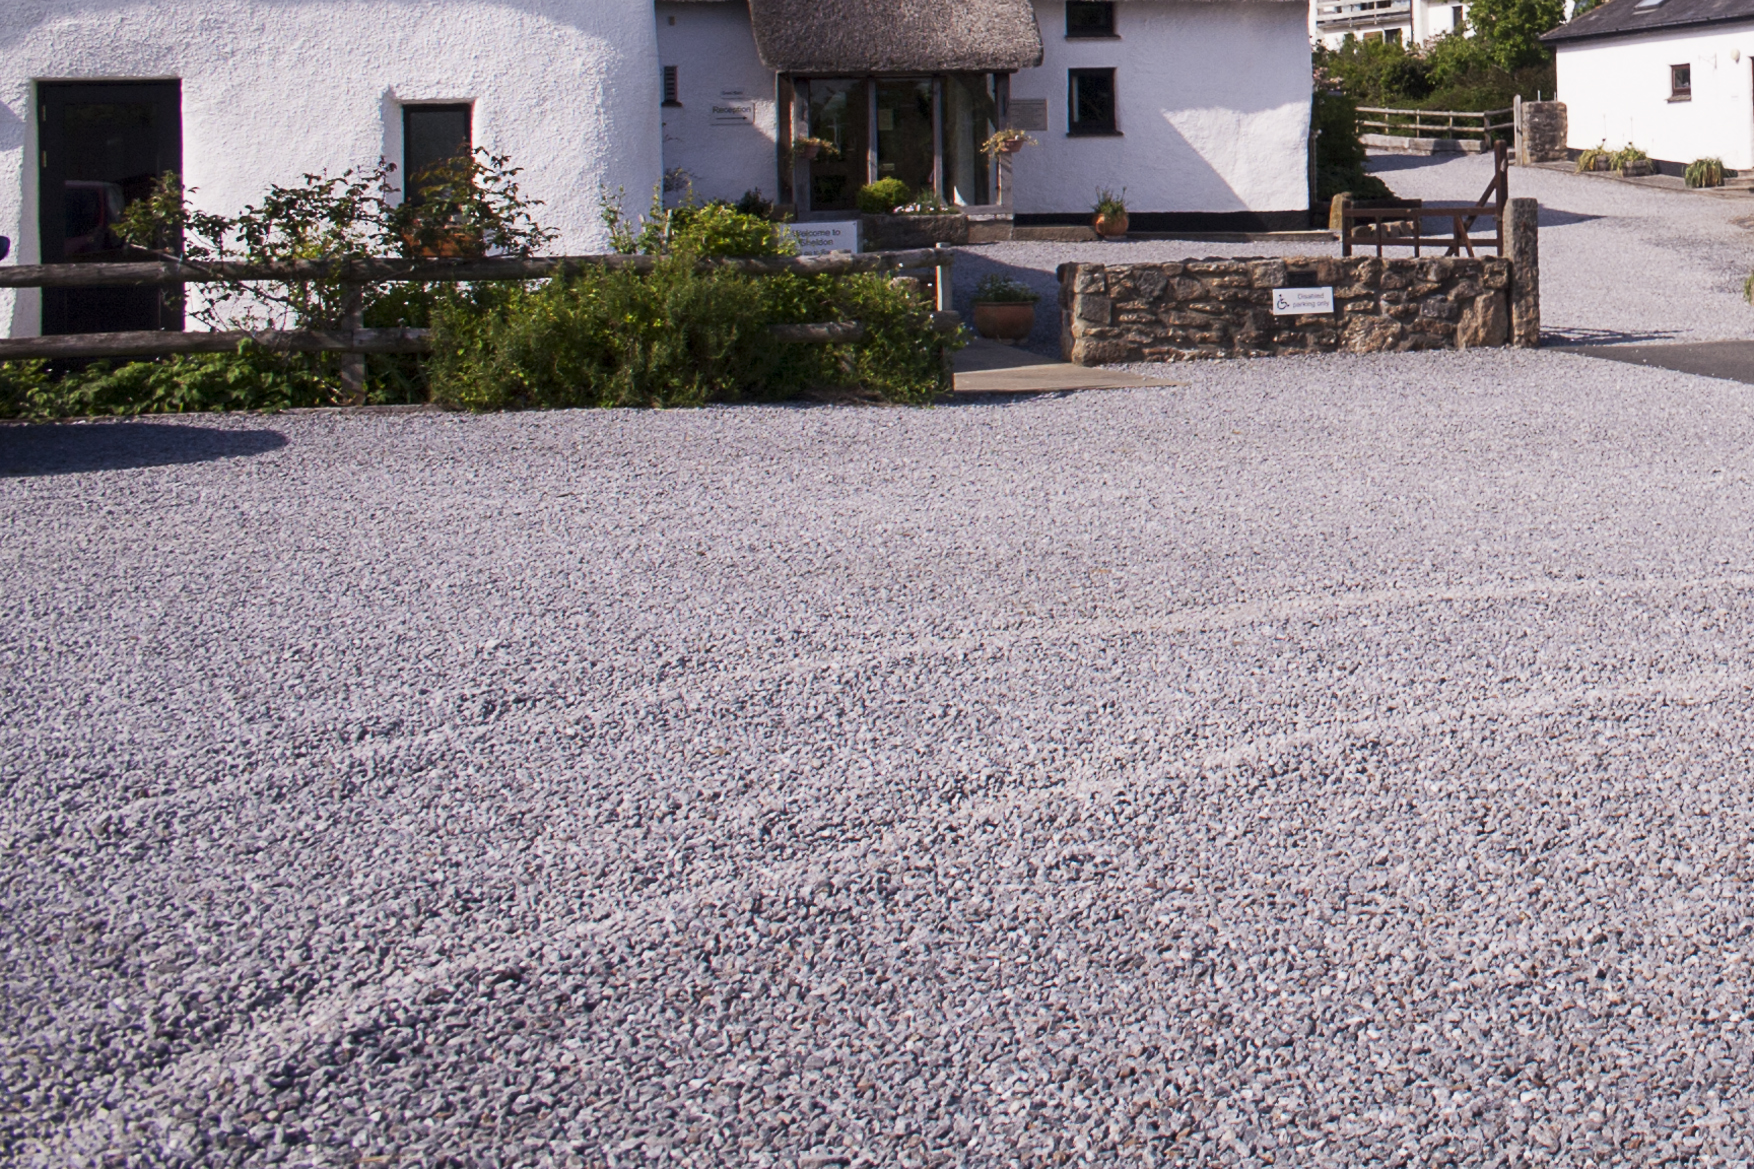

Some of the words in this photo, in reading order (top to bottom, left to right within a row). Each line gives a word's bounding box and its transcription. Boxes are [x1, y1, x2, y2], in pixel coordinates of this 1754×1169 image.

[712, 105, 752, 114] Reception
[832, 228, 841, 236] to
[1297, 292, 1325, 300] Disabled
[1292, 301, 1316, 309] parking
[1317, 300, 1330, 308] only
